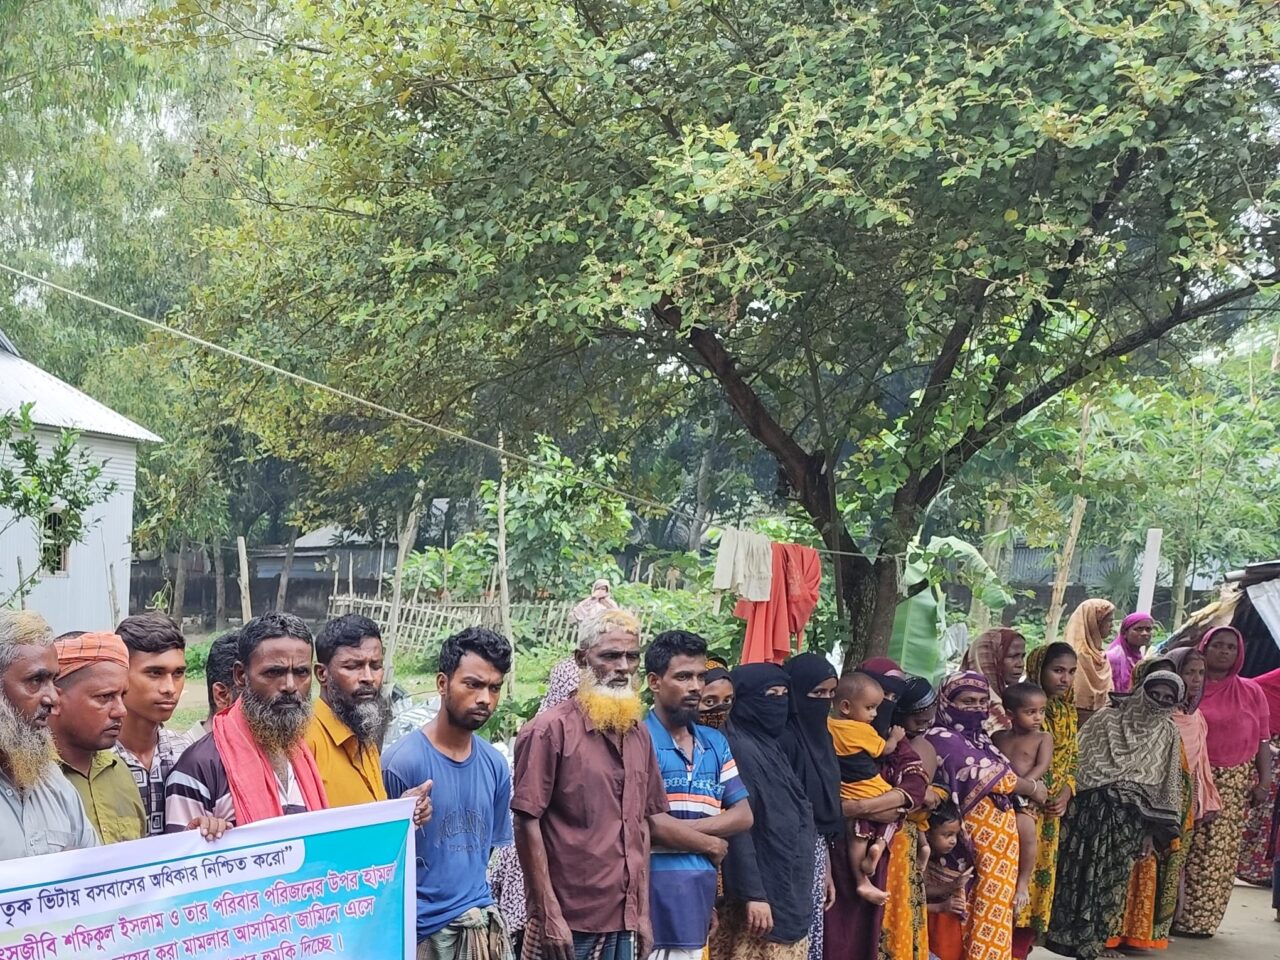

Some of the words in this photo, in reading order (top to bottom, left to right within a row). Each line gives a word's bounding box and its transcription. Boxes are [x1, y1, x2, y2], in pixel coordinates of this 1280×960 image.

[37, 889, 80, 913] ভিটায়
[84, 876, 145, 900] বসবাসের
[150, 865, 198, 890] অধিকার
[201, 855, 247, 880] নিশ্চিত
[62, 923, 114, 951] শফিকুল
[118, 912, 164, 939] ইসলাম
[169, 911, 180, 927] ও
[183, 900, 208, 923] তার
[213, 890, 259, 918] পরিবার
[264, 877, 324, 907] পরিজনের
[327, 870, 358, 892] উপর
[361, 861, 397, 887] হামল
[182, 927, 229, 956] মামলার
[233, 914, 293, 942] আসামিরা
[295, 902, 339, 927] জামিনে
[344, 896, 375, 916] এসে
[300, 935, 334, 956] দিচ্ছে
